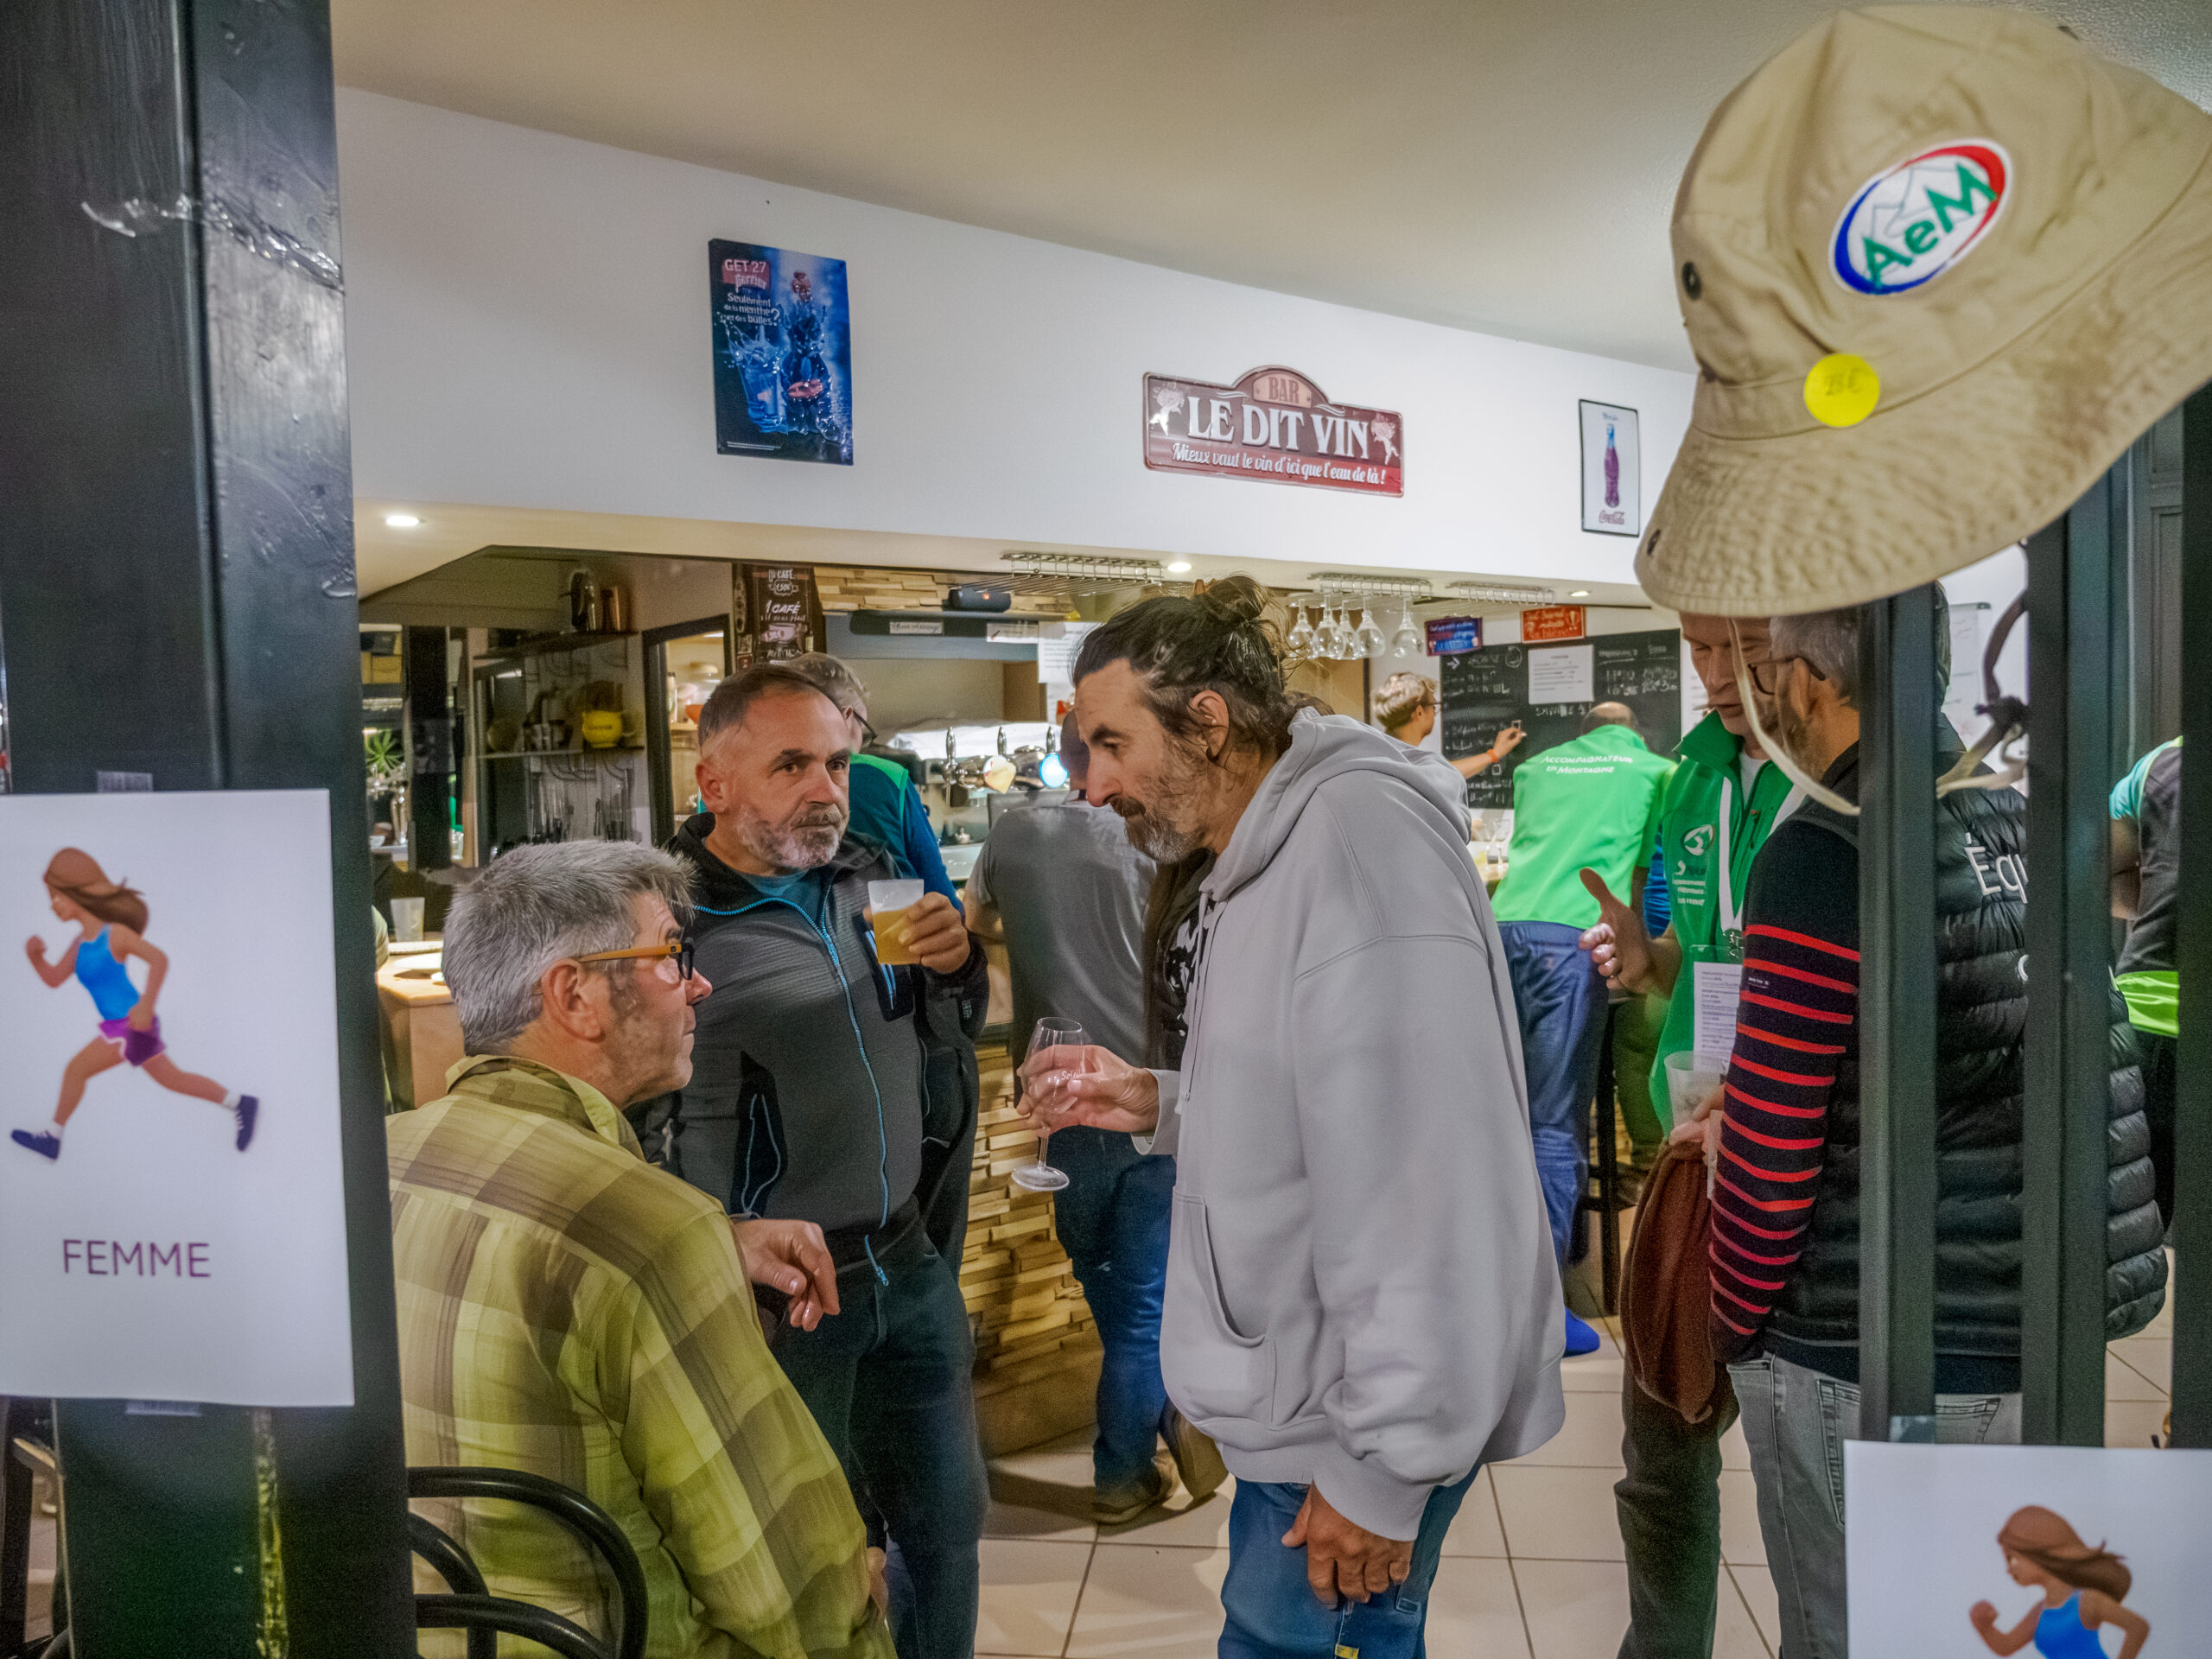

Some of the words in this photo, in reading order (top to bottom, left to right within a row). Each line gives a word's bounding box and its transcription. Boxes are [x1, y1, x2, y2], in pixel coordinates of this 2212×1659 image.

[1862, 162, 1999, 296] AeM
[724, 259, 749, 272] GET
[752, 261, 766, 273] 27
[728, 292, 771, 307] Seulement
[739, 305, 770, 316] menthe
[747, 315, 772, 326] bulles
[1268, 377, 1300, 404] BAR
[1186, 396, 1236, 442] LE
[1242, 404, 1306, 451] DIT
[1310, 414, 1369, 460] VIN
[1172, 442, 1211, 464] Mieux
[1212, 452, 1240, 468] vaut
[1242, 452, 1252, 469] le
[1254, 454, 1273, 472] vin
[1301, 462, 1322, 480] que
[1323, 461, 1351, 481] l'eau
[1352, 467, 1366, 483] de
[1366, 467, 1379, 485] là
[772, 601, 802, 614] CAFÉ
[1556, 766, 1615, 774] MONTAGNE
[62, 1238, 212, 1278] FEMME
